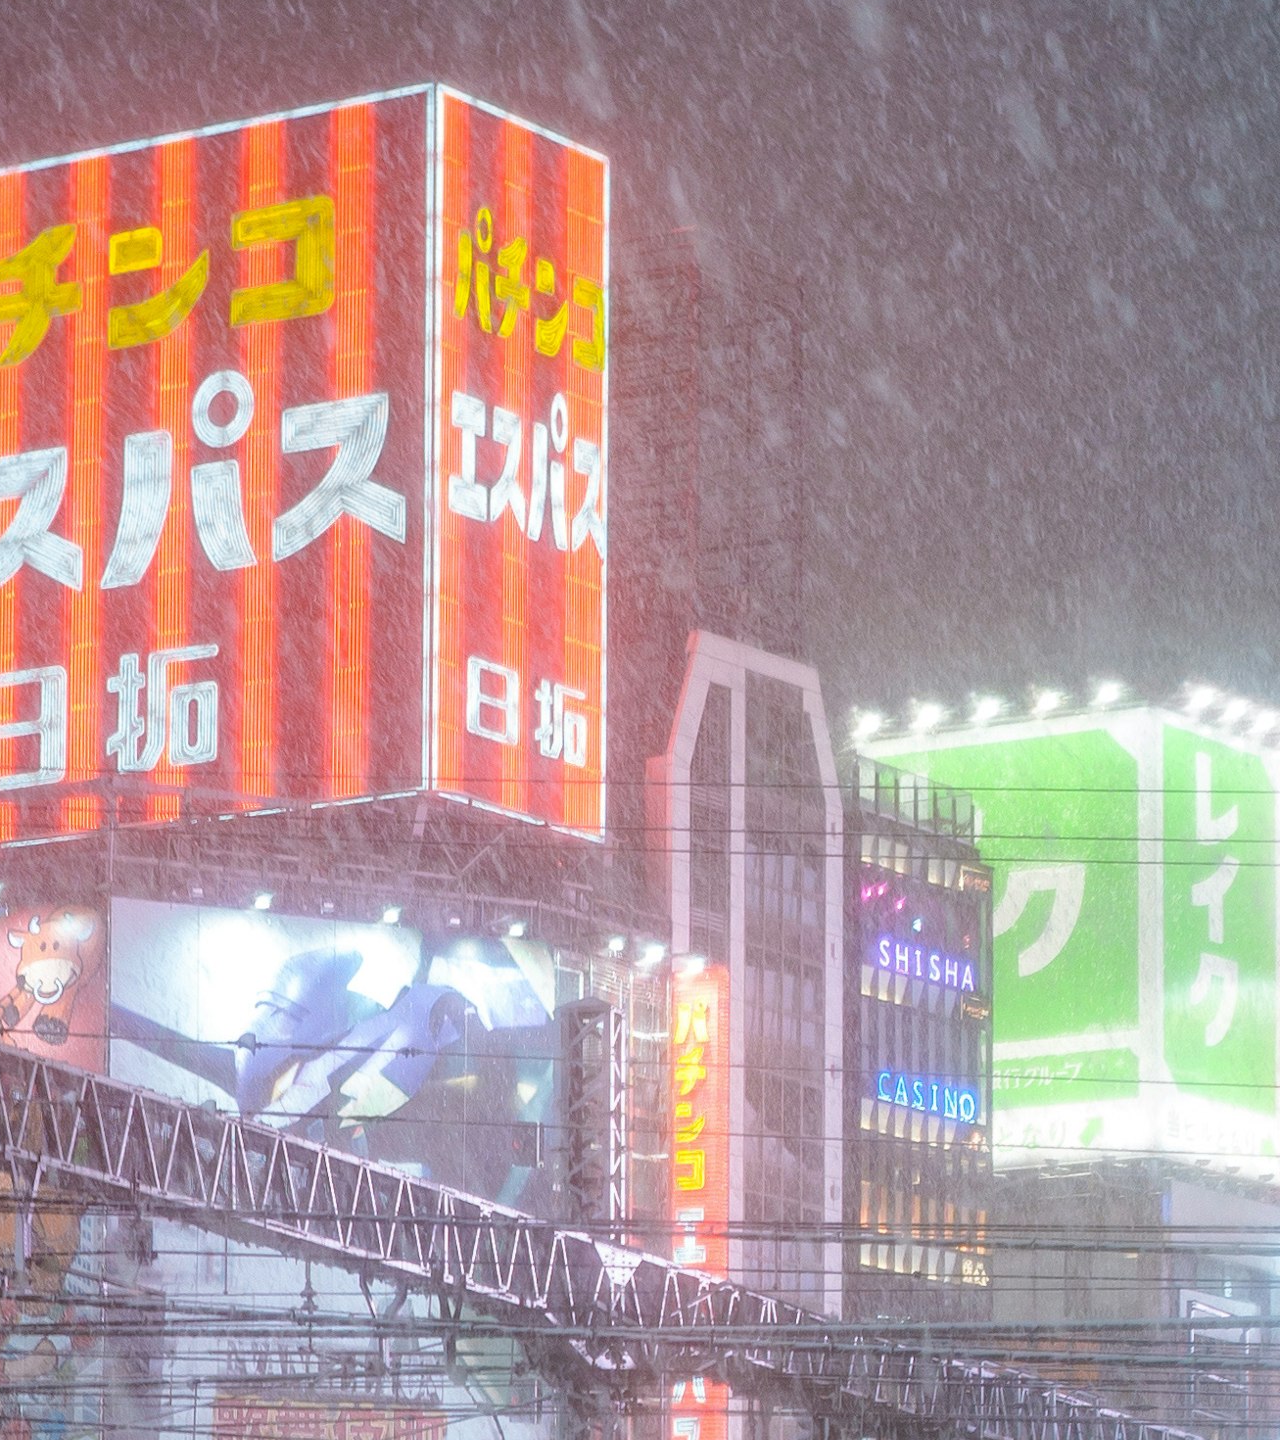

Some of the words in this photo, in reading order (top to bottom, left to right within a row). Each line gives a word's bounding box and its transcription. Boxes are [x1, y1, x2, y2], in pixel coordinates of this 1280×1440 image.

[453, 206, 606, 374] パチンコ
[448, 391, 607, 562] エスパス
[465, 655, 587, 768] 日拓
[878, 938, 975, 993] SHISHA
[1191, 751, 1240, 1048] レイク
[673, 995, 711, 1192] パチンコ
[877, 1072, 976, 1124] CASINO
